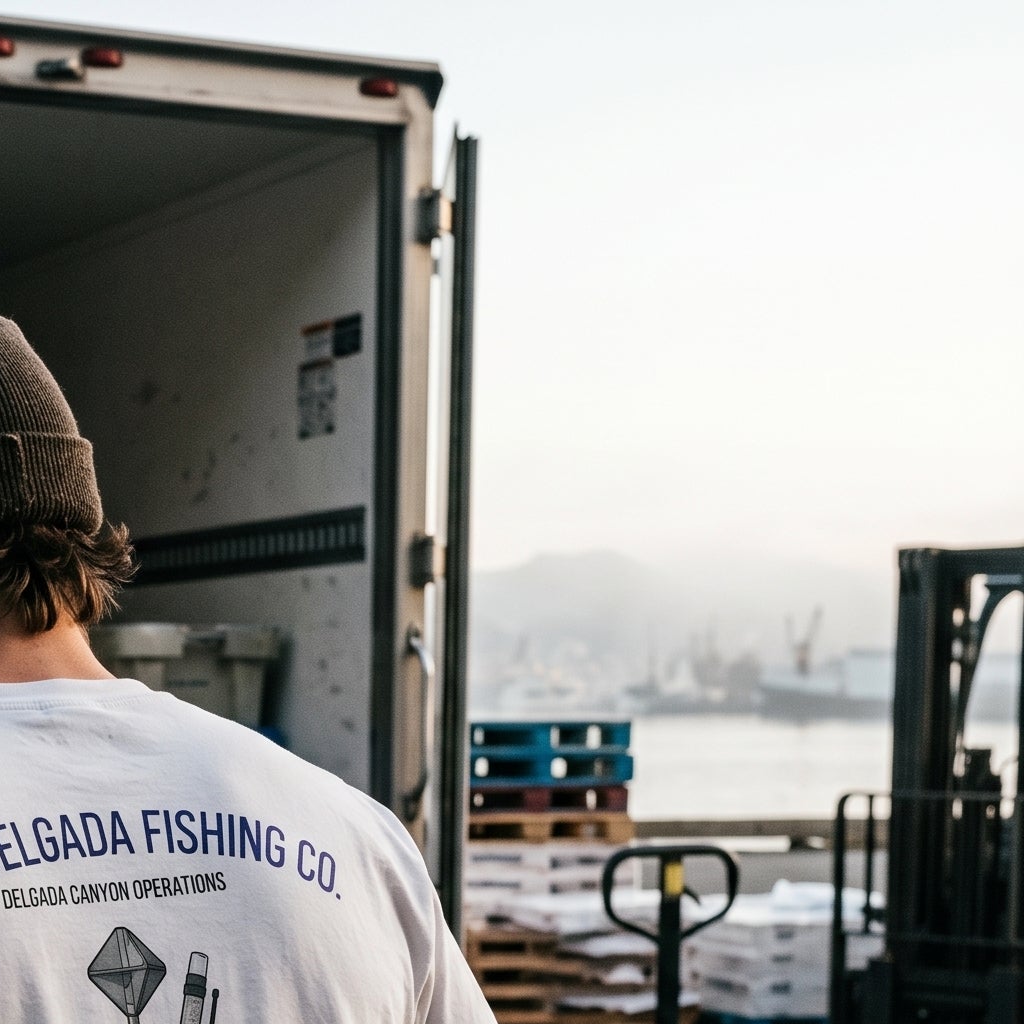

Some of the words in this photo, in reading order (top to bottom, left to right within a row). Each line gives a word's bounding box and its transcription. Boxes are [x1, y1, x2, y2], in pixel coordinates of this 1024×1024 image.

[141, 809, 286, 867] FISHING
[296, 839, 341, 901] CO.
[1, 885, 68, 909] DELGADA
[70, 880, 131, 906] CANYON
[131, 871, 227, 900] OPERATIONS
